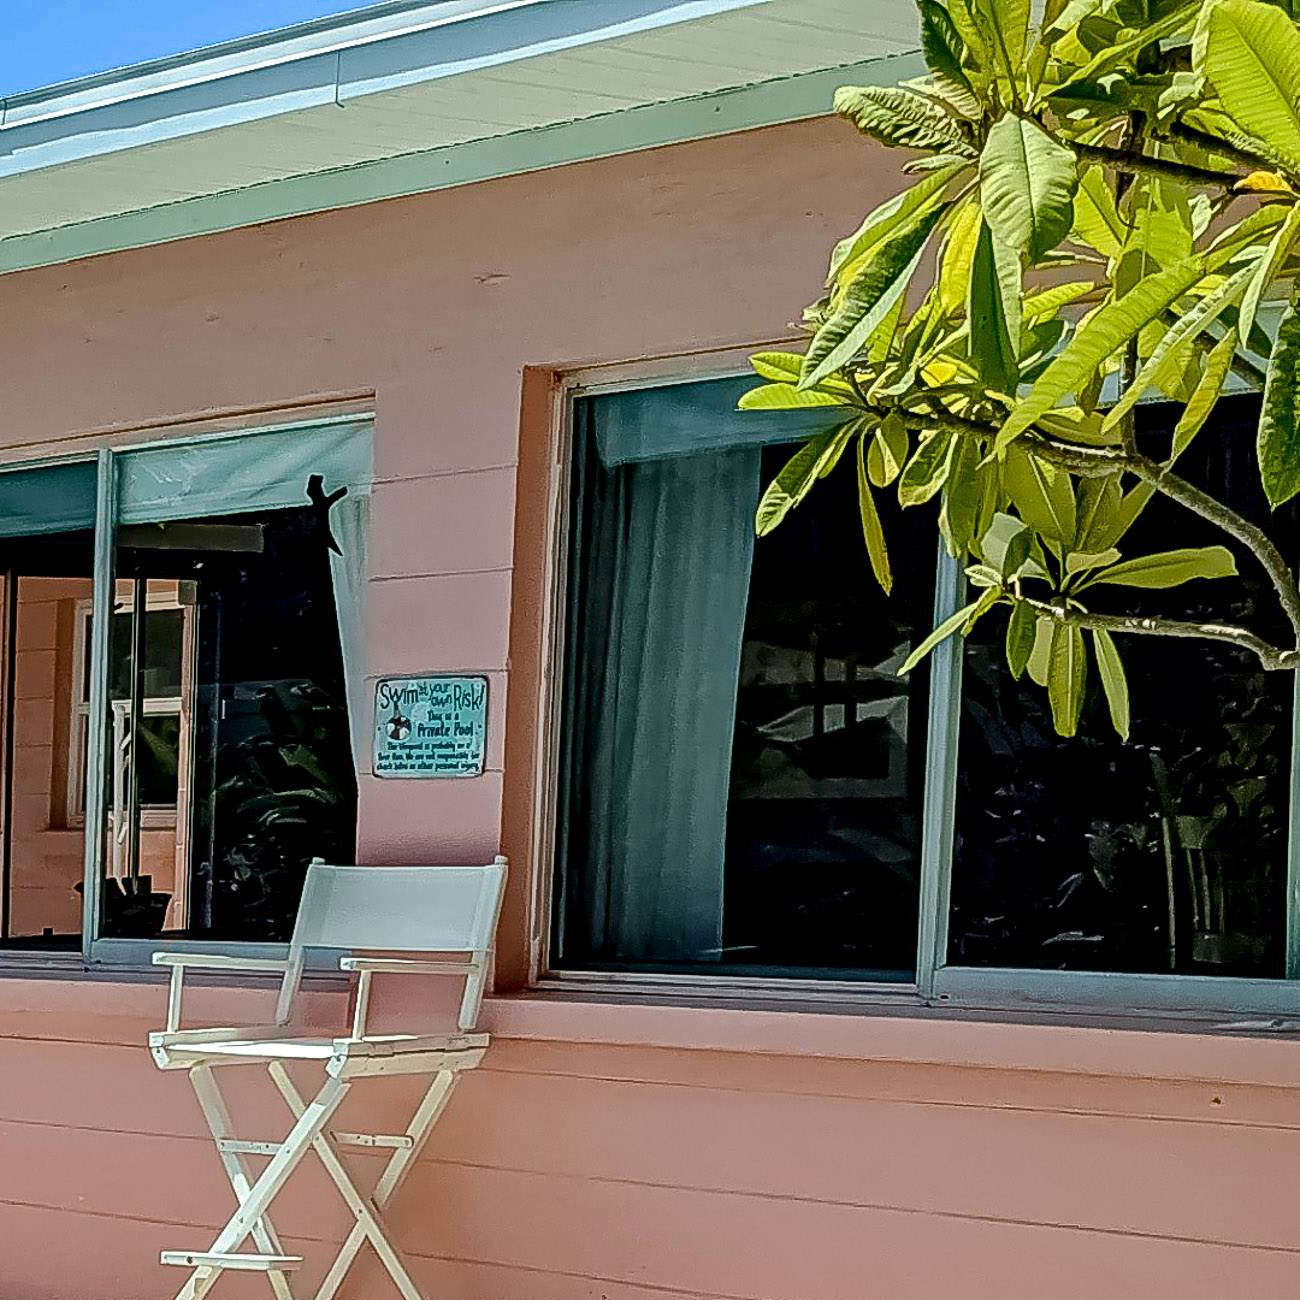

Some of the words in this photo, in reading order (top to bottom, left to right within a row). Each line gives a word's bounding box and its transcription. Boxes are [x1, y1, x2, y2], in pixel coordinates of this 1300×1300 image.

[380, 684, 419, 709] Swim
[429, 683, 451, 701] your
[431, 694, 453, 707] own
[454, 683, 486, 711] Risk!
[427, 710, 442, 722] This
[417, 721, 451, 737] Private
